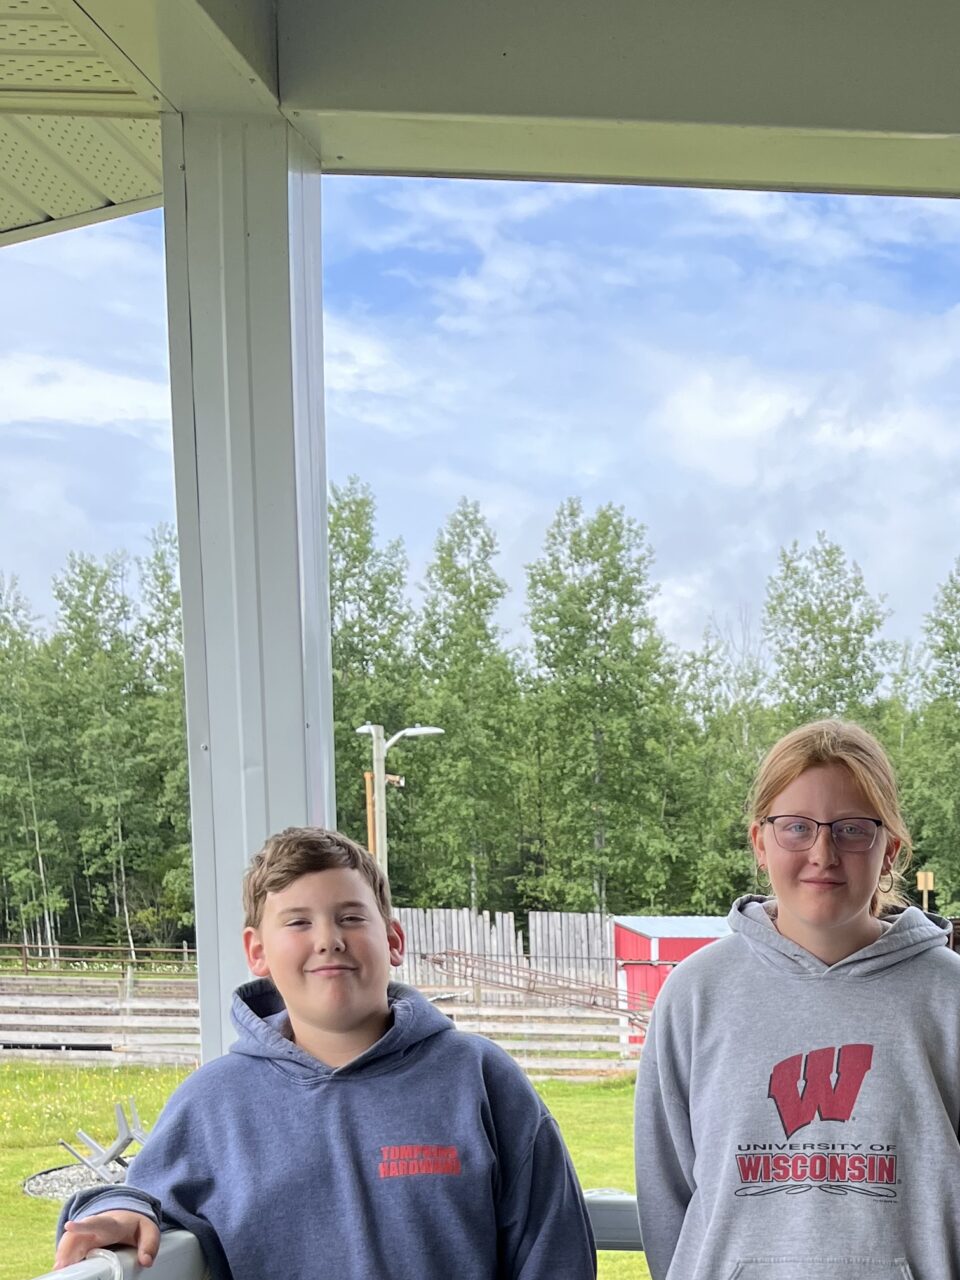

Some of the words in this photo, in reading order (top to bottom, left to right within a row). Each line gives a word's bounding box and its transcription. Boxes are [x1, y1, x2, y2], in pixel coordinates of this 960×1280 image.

[768, 1044, 874, 1140] W
[737, 1143, 863, 1151] UNIVERSITY
[869, 1144, 897, 1152] OF
[735, 1153, 897, 1184] WISCONSIN
